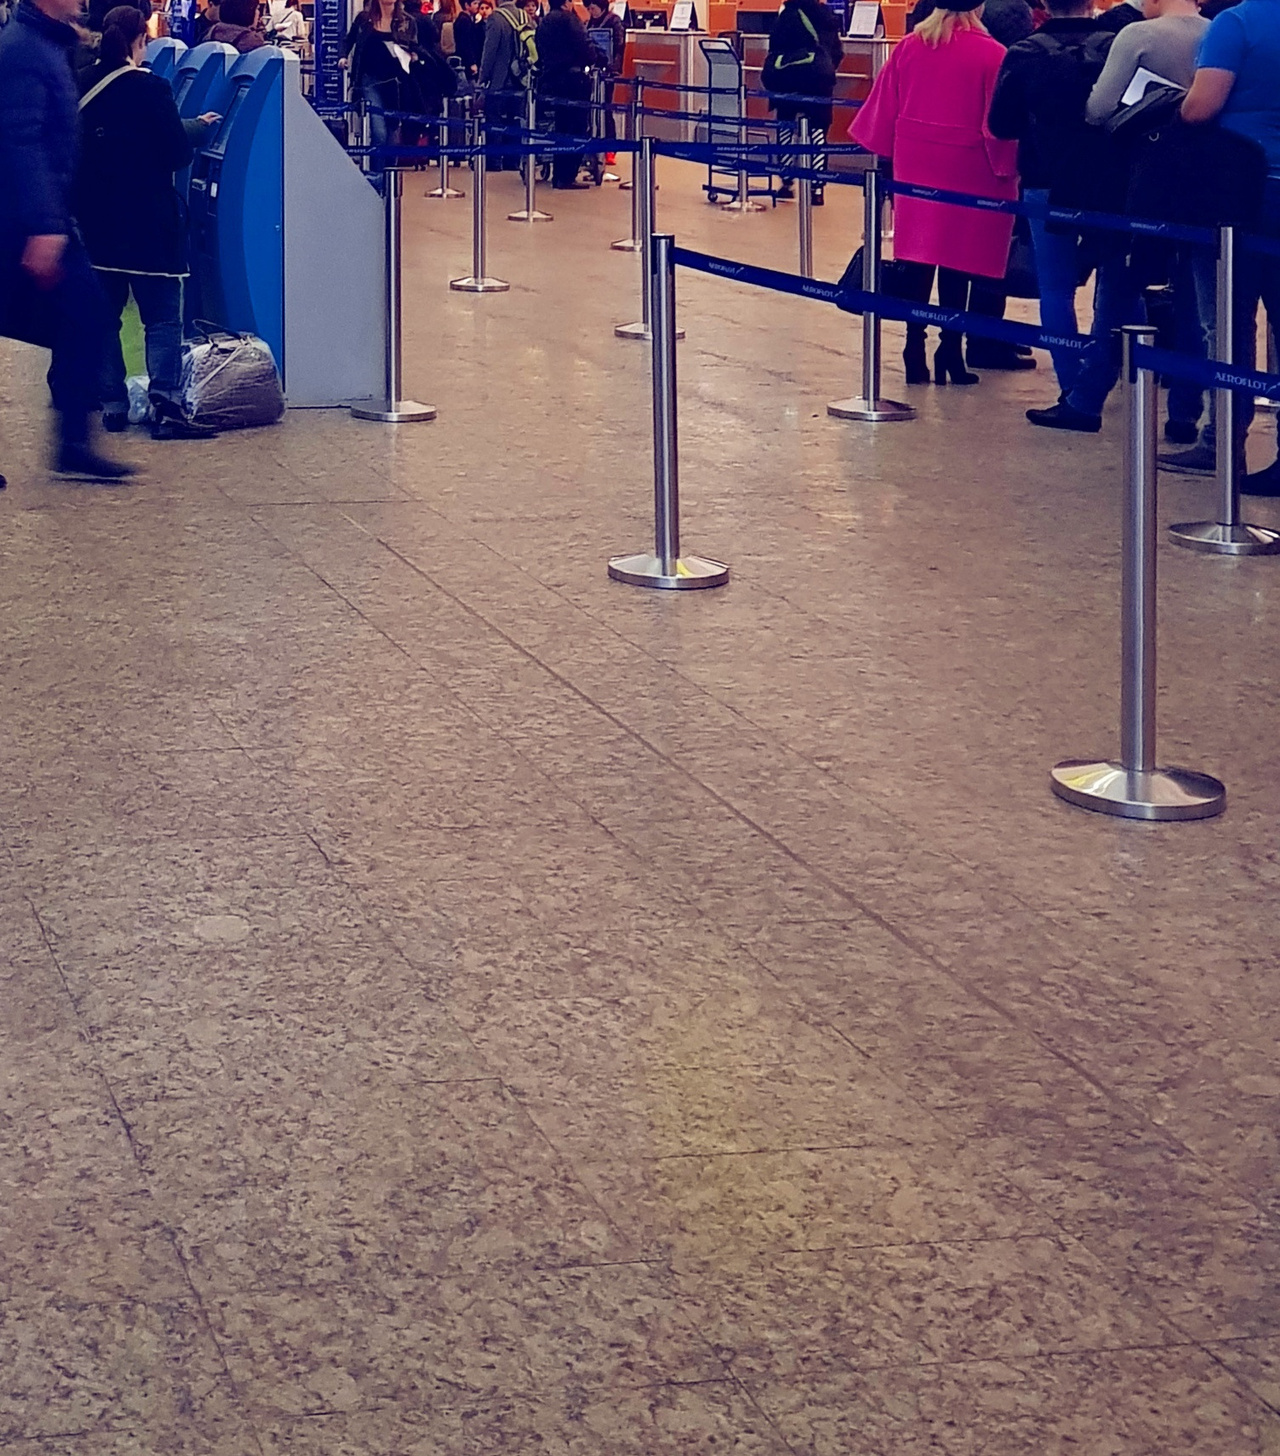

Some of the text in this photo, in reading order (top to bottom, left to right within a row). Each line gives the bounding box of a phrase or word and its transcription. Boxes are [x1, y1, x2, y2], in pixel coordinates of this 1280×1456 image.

[802, 283, 834, 298] AEROFLOT
[911, 307, 948, 323] AEROFLOT
[1038, 333, 1082, 349] AEROFLOT
[1214, 371, 1267, 391] AEROFLOT
